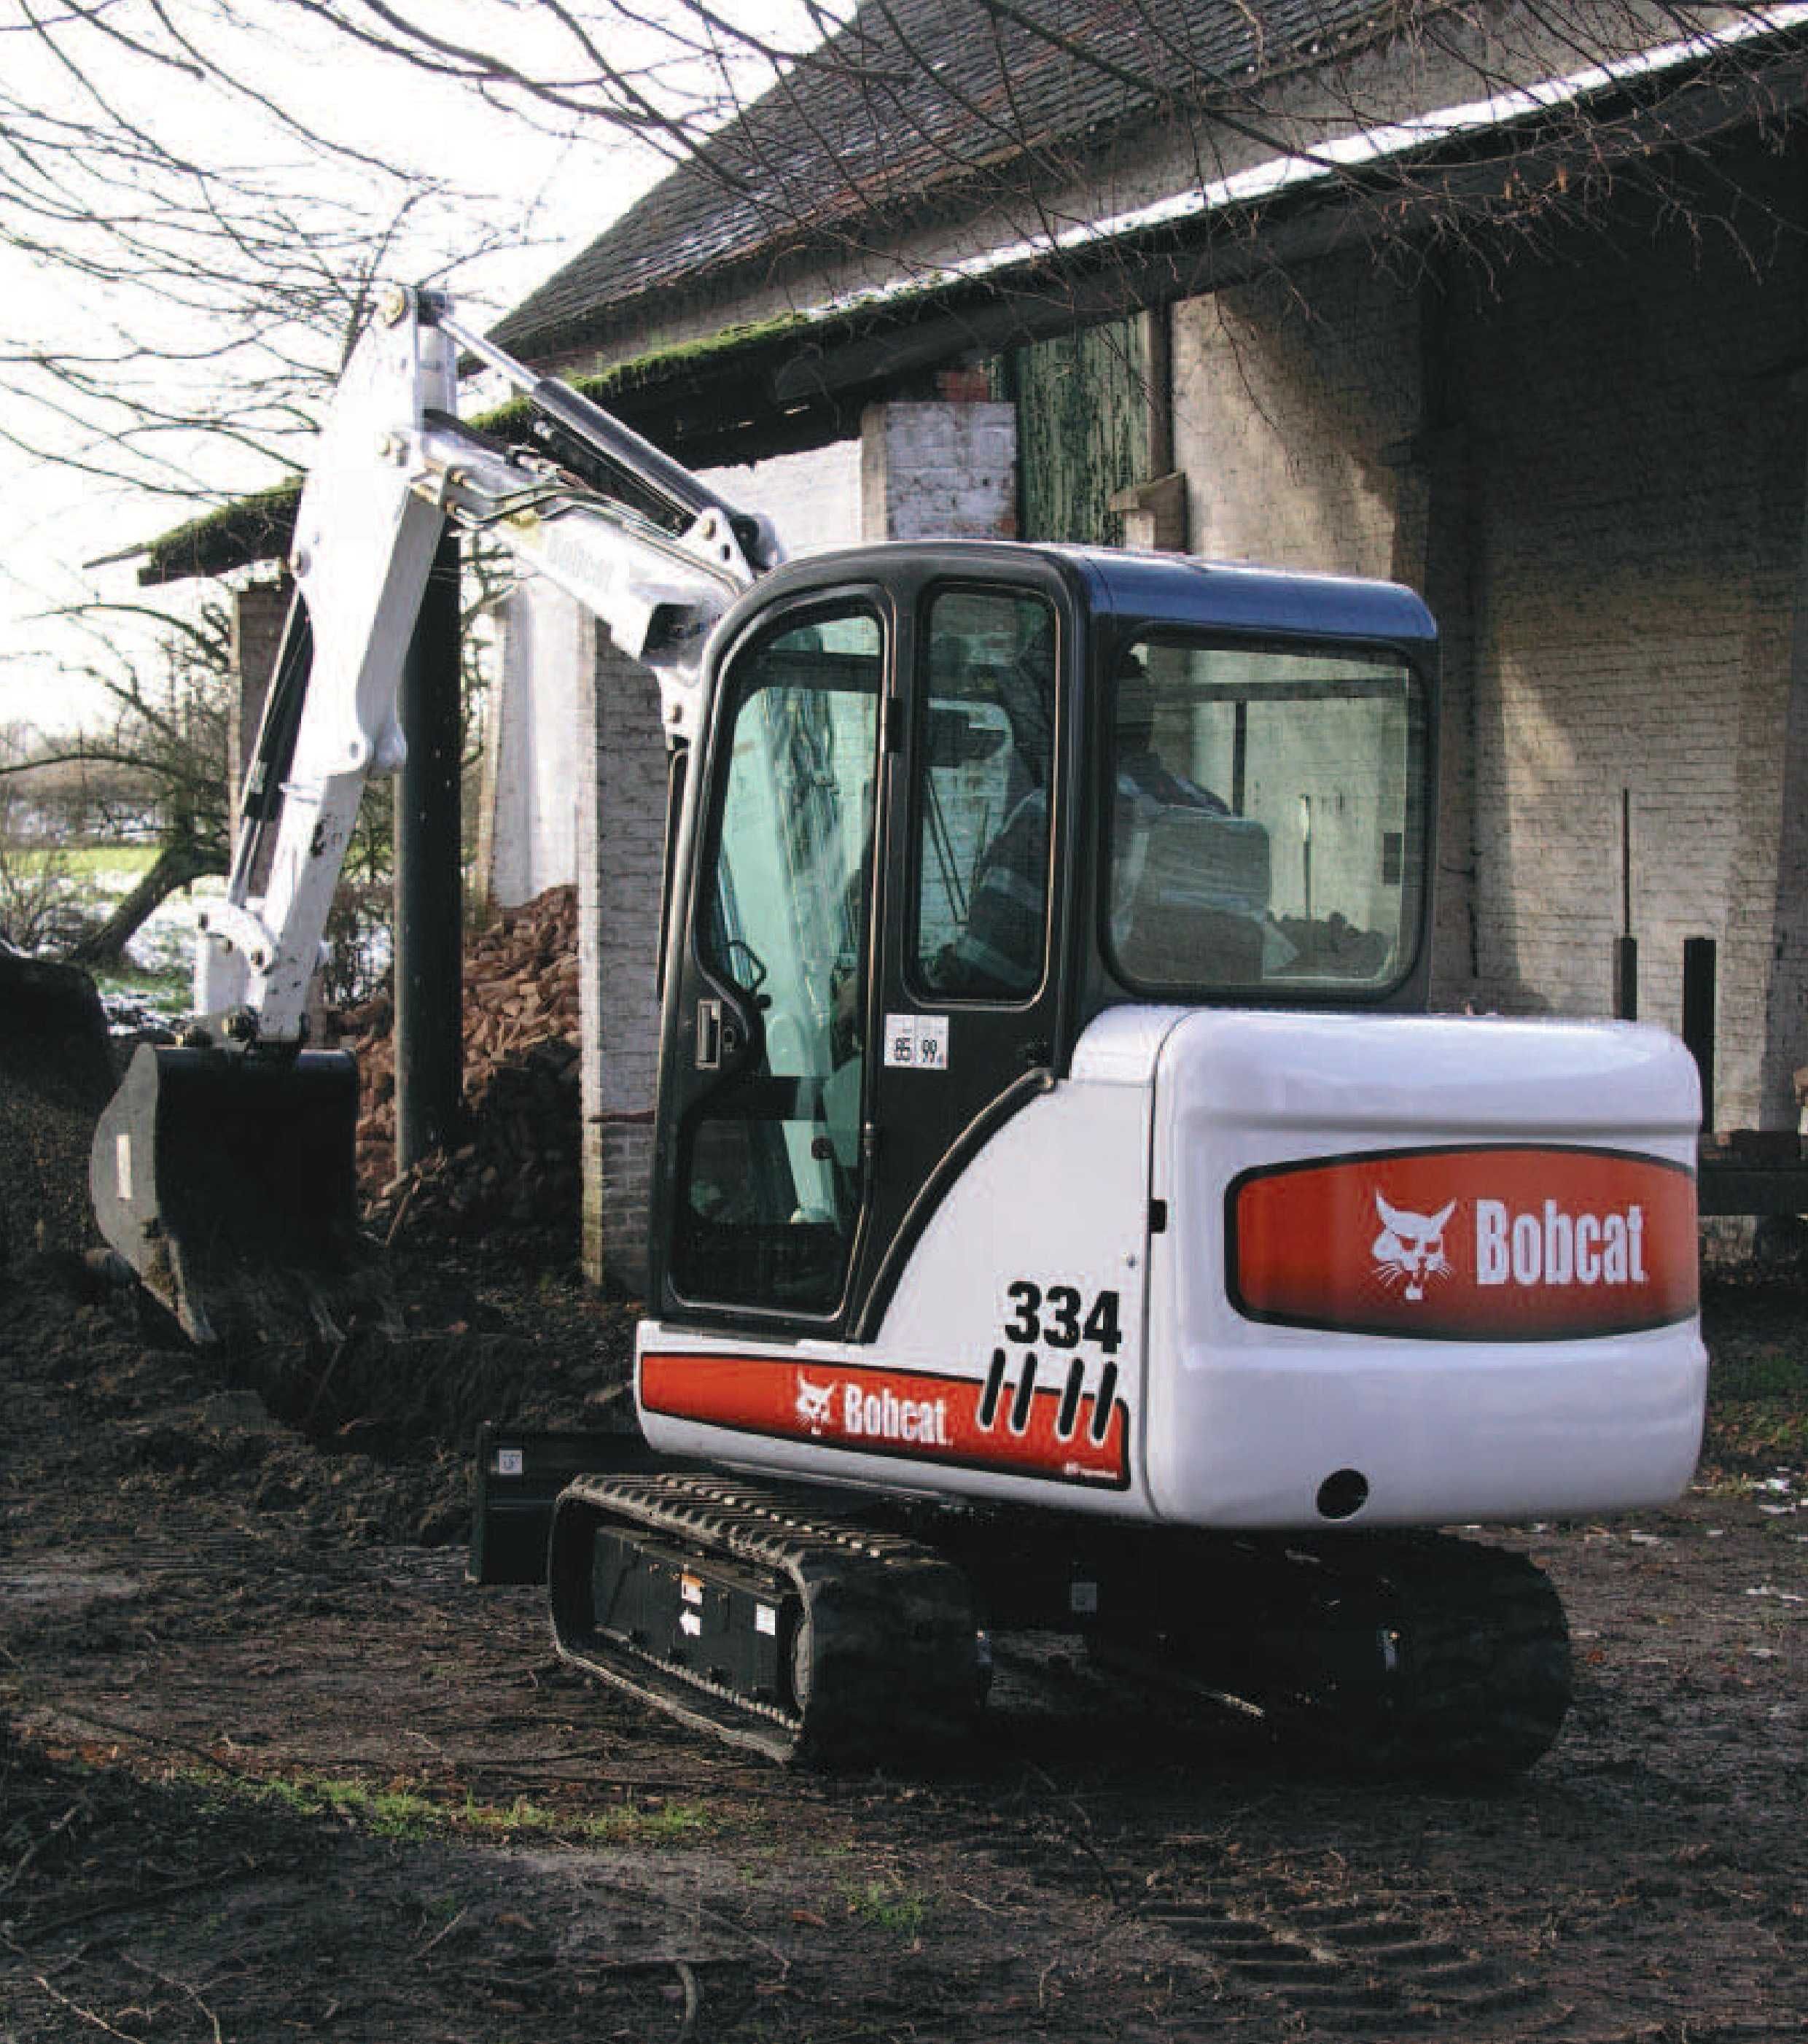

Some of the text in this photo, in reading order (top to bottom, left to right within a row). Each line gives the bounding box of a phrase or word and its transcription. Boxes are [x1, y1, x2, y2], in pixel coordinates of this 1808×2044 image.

[1476, 1199, 1646, 1285] Bobcat
[1004, 1281, 1121, 1353] 334
[844, 1384, 948, 1445] Bobcat
